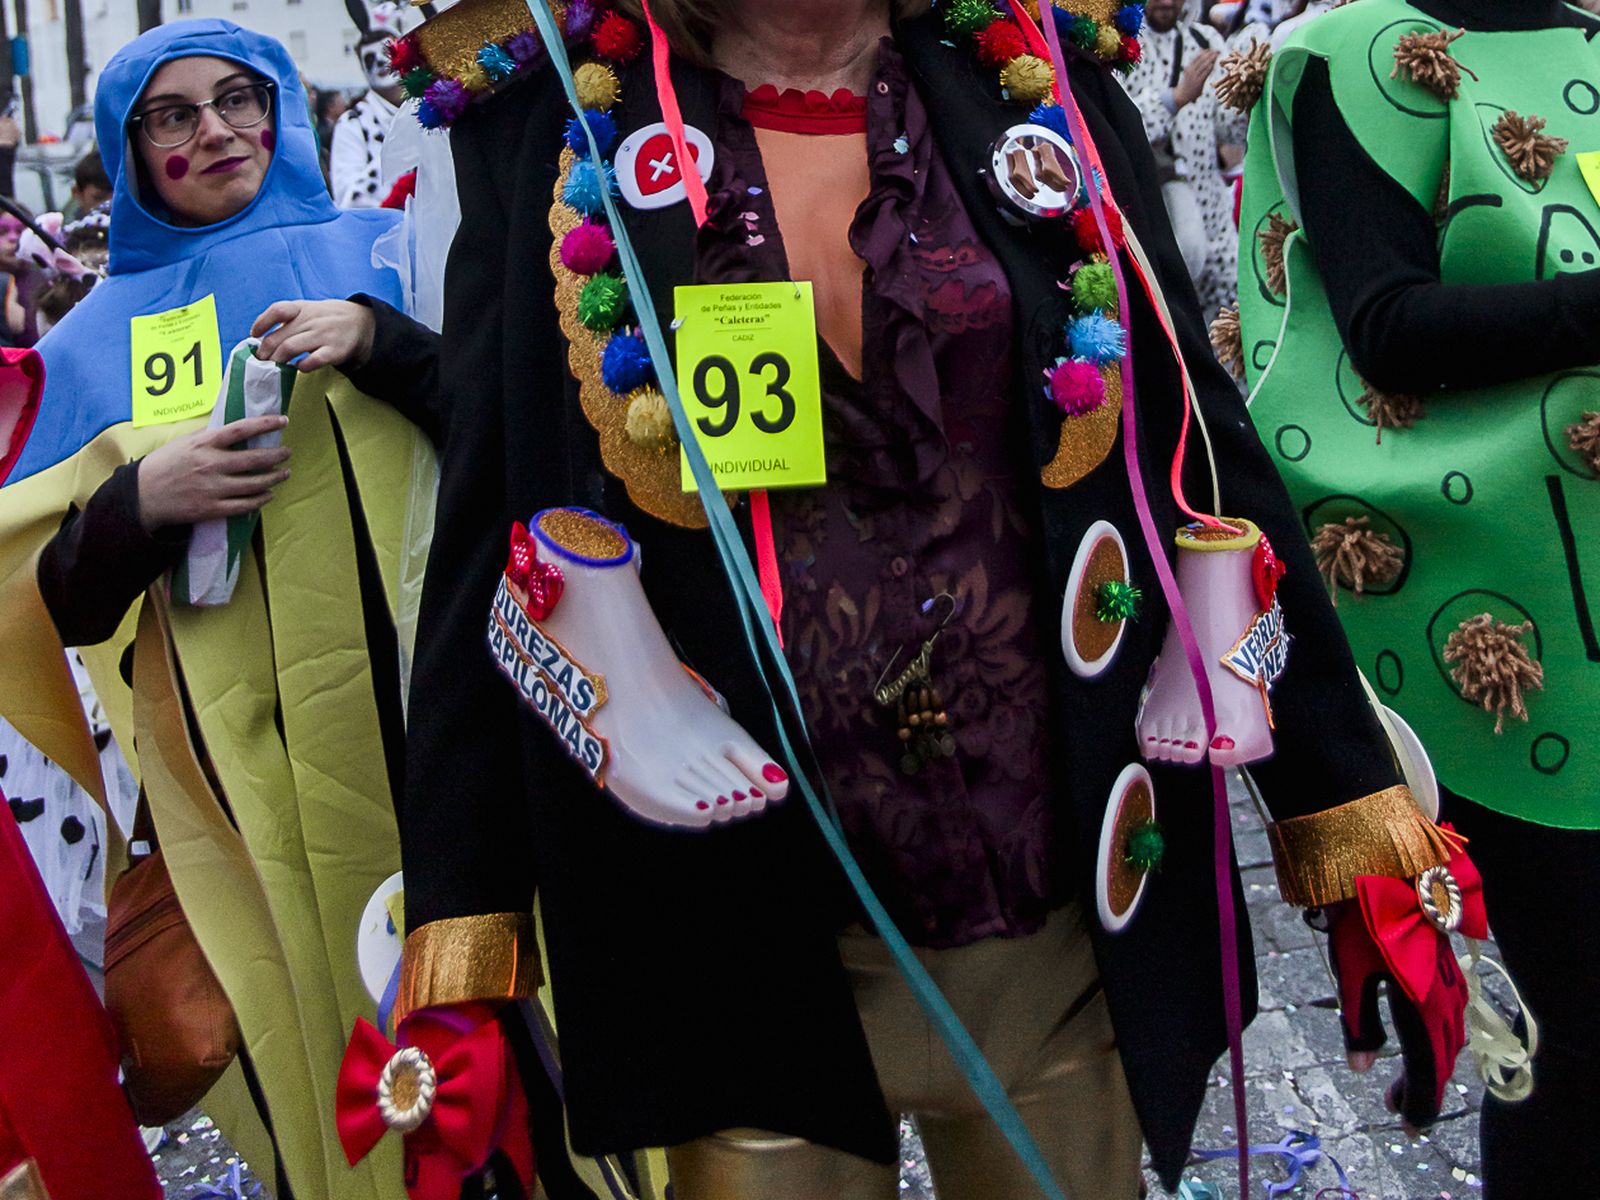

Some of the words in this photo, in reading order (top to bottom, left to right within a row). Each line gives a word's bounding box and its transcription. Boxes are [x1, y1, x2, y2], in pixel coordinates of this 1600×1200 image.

[144, 340, 204, 397] 91
[153, 399, 205, 417] INDIVIDUAL
[693, 351, 796, 438] 93
[710, 458, 791, 474] INDIVIDUAL
